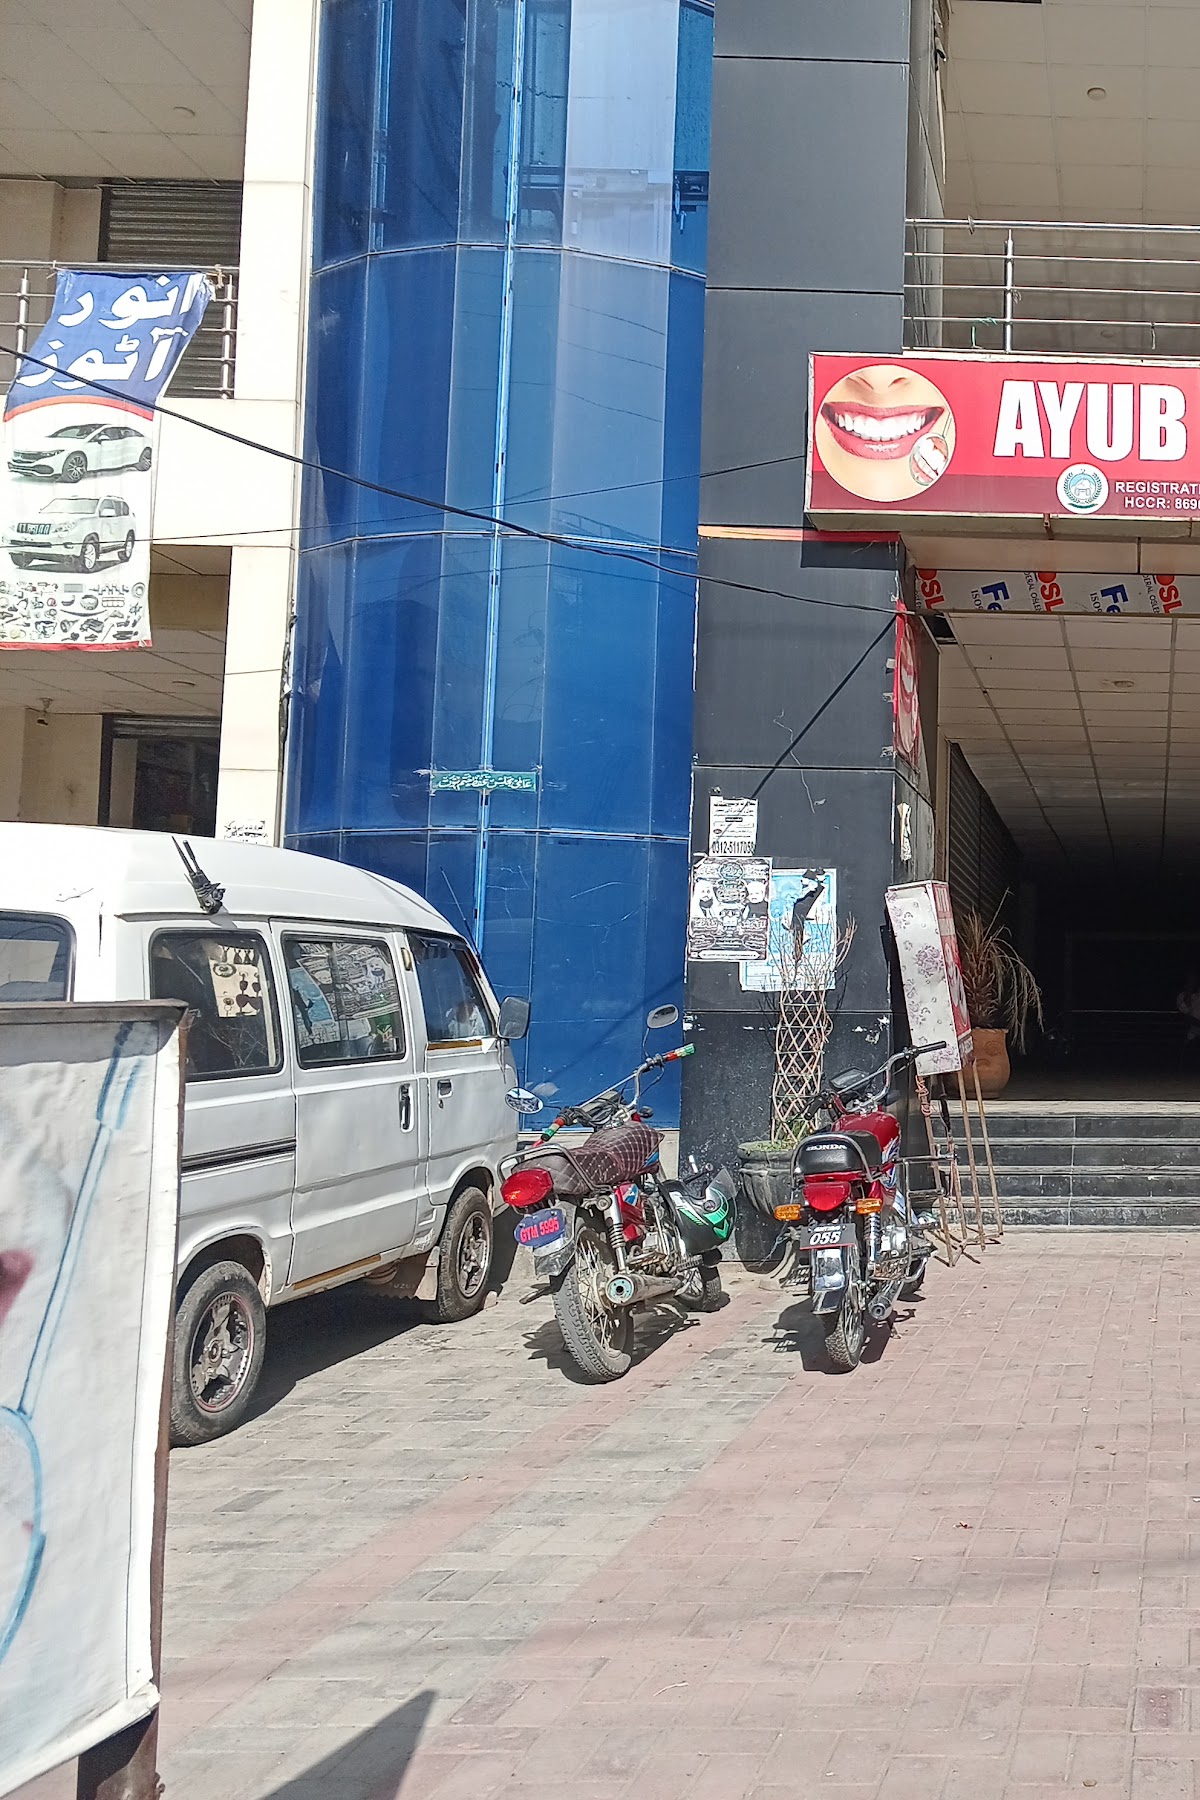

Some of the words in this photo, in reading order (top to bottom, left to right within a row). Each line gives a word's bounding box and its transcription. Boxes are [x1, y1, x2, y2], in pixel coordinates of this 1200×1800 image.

[16, 326, 189, 391] آٹوز
[993, 379, 1187, 462] AYUB
[1125, 497, 1170, 509] HCCR:
